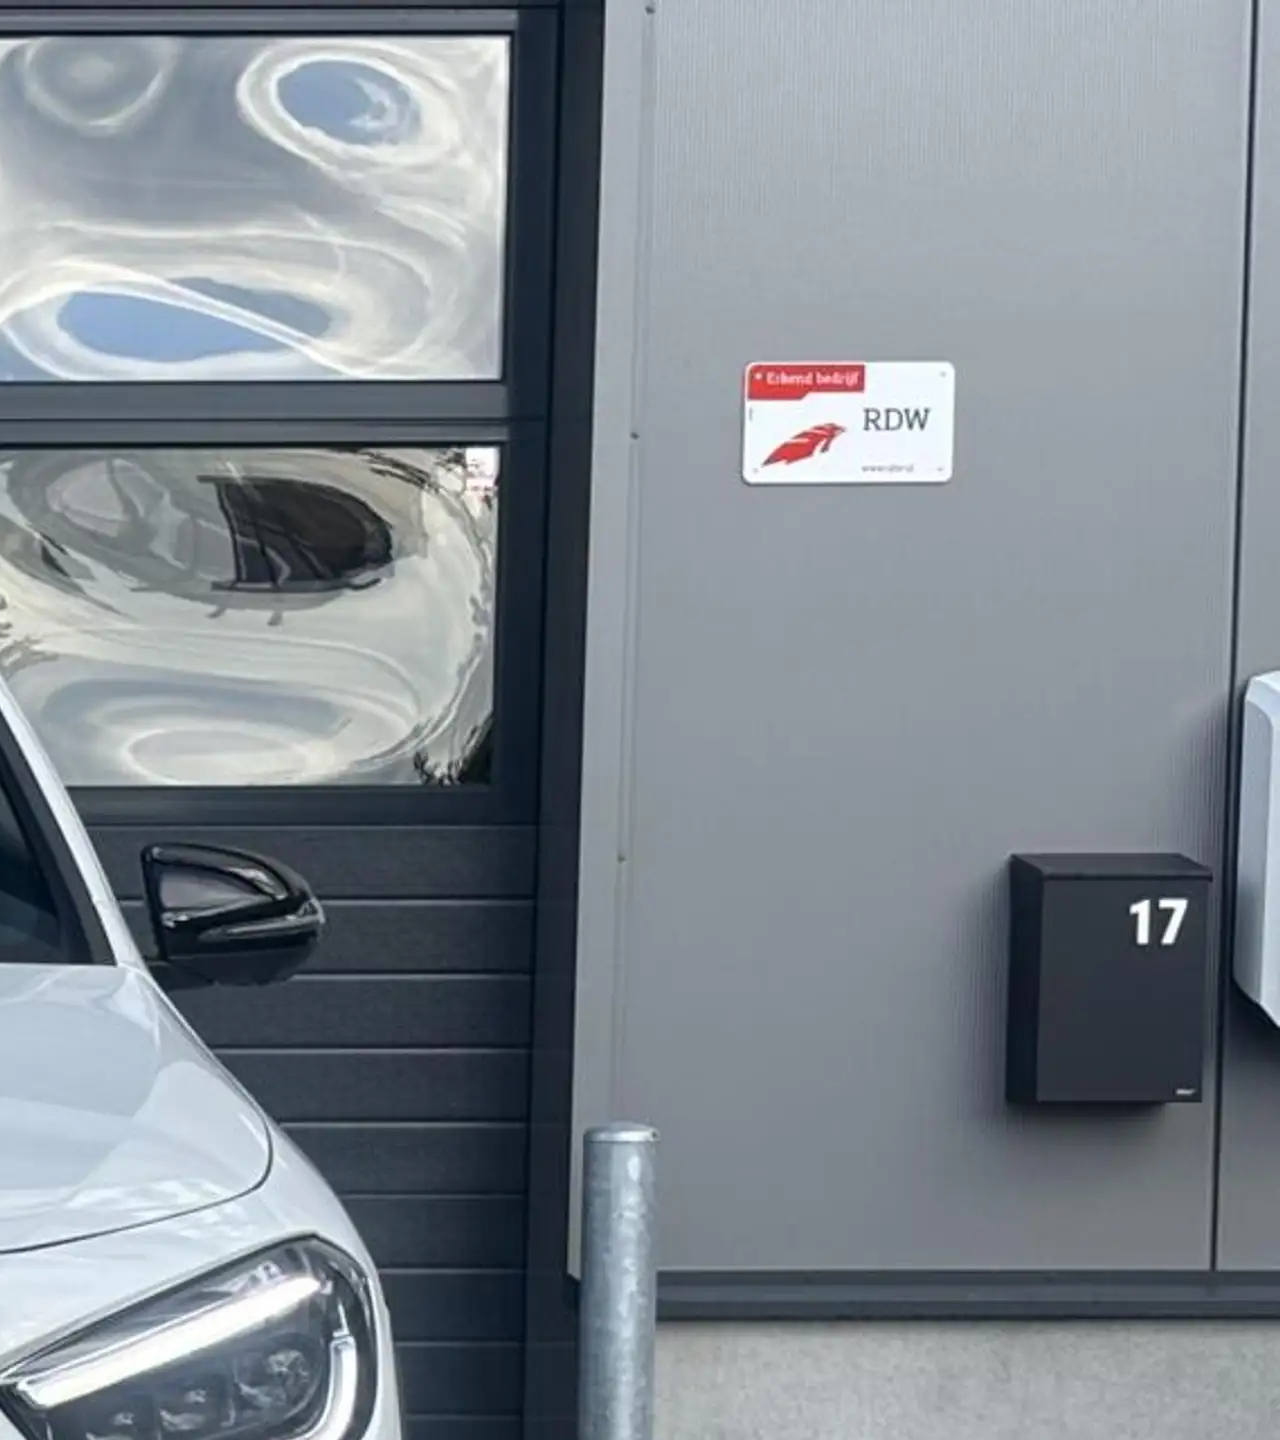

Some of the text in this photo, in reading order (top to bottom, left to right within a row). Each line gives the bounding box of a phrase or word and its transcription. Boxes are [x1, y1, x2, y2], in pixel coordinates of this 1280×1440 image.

[816, 371, 860, 387] bedrijf
[863, 407, 931, 431] RDW
[1129, 898, 1189, 945] 17
